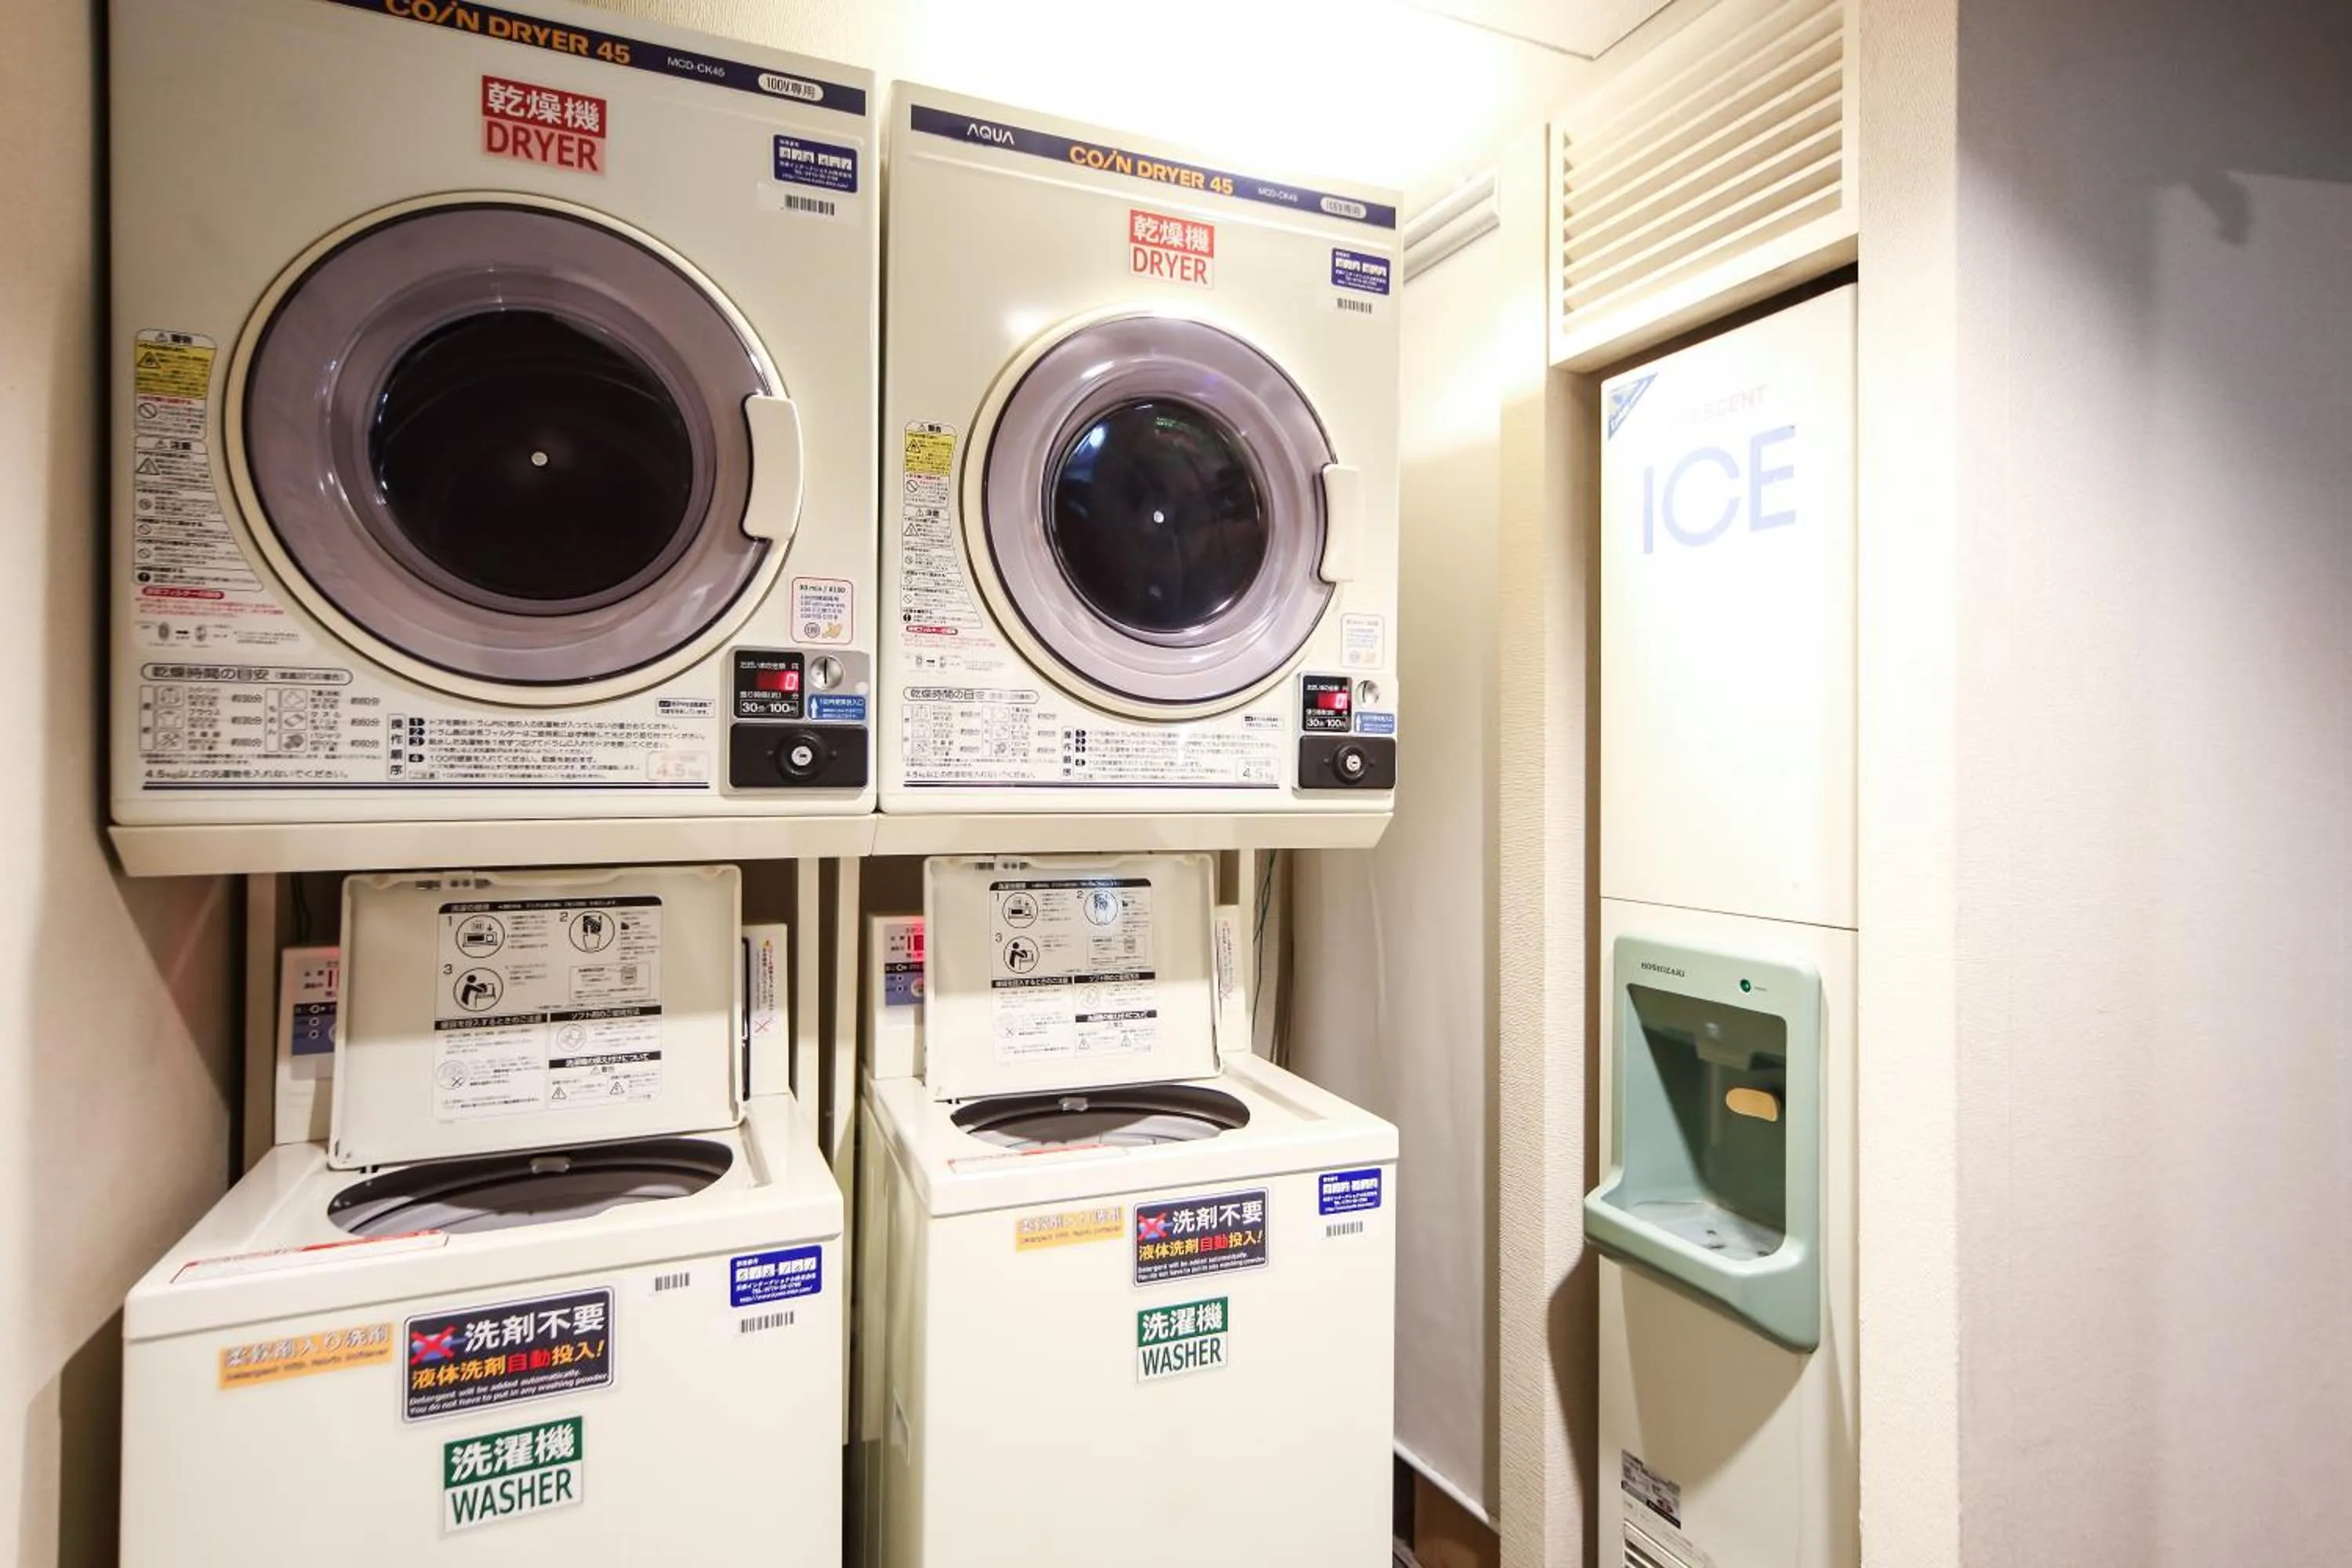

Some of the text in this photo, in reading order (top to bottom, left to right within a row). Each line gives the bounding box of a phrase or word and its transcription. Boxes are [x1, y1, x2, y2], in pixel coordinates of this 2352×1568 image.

[488, 15, 589, 56] DRYER
[597, 41, 631, 64] 45
[667, 56, 726, 78] MCD-CK45
[487, 82, 601, 132] 乾燥機
[765, 76, 816, 99] 100V専用
[486, 120, 598, 171] DRYER
[967, 123, 1014, 145] AQUA
[1137, 159, 1205, 189] DRYER
[1210, 176, 1234, 195] 45
[1134, 214, 1209, 253] 乾燥機
[1133, 245, 1208, 285] DRYER
[1642, 423, 1797, 555] ICE
[443, 964, 453, 975] 3
[1172, 1200, 1263, 1235] 洗剤不要
[464, 1302, 605, 1352] 洗剤不要
[1142, 1301, 1223, 1343] 洗濯機
[1142, 1337, 1222, 1376] WASHER
[450, 1423, 575, 1483] 洗濯機
[451, 1466, 573, 1526] WASHER
